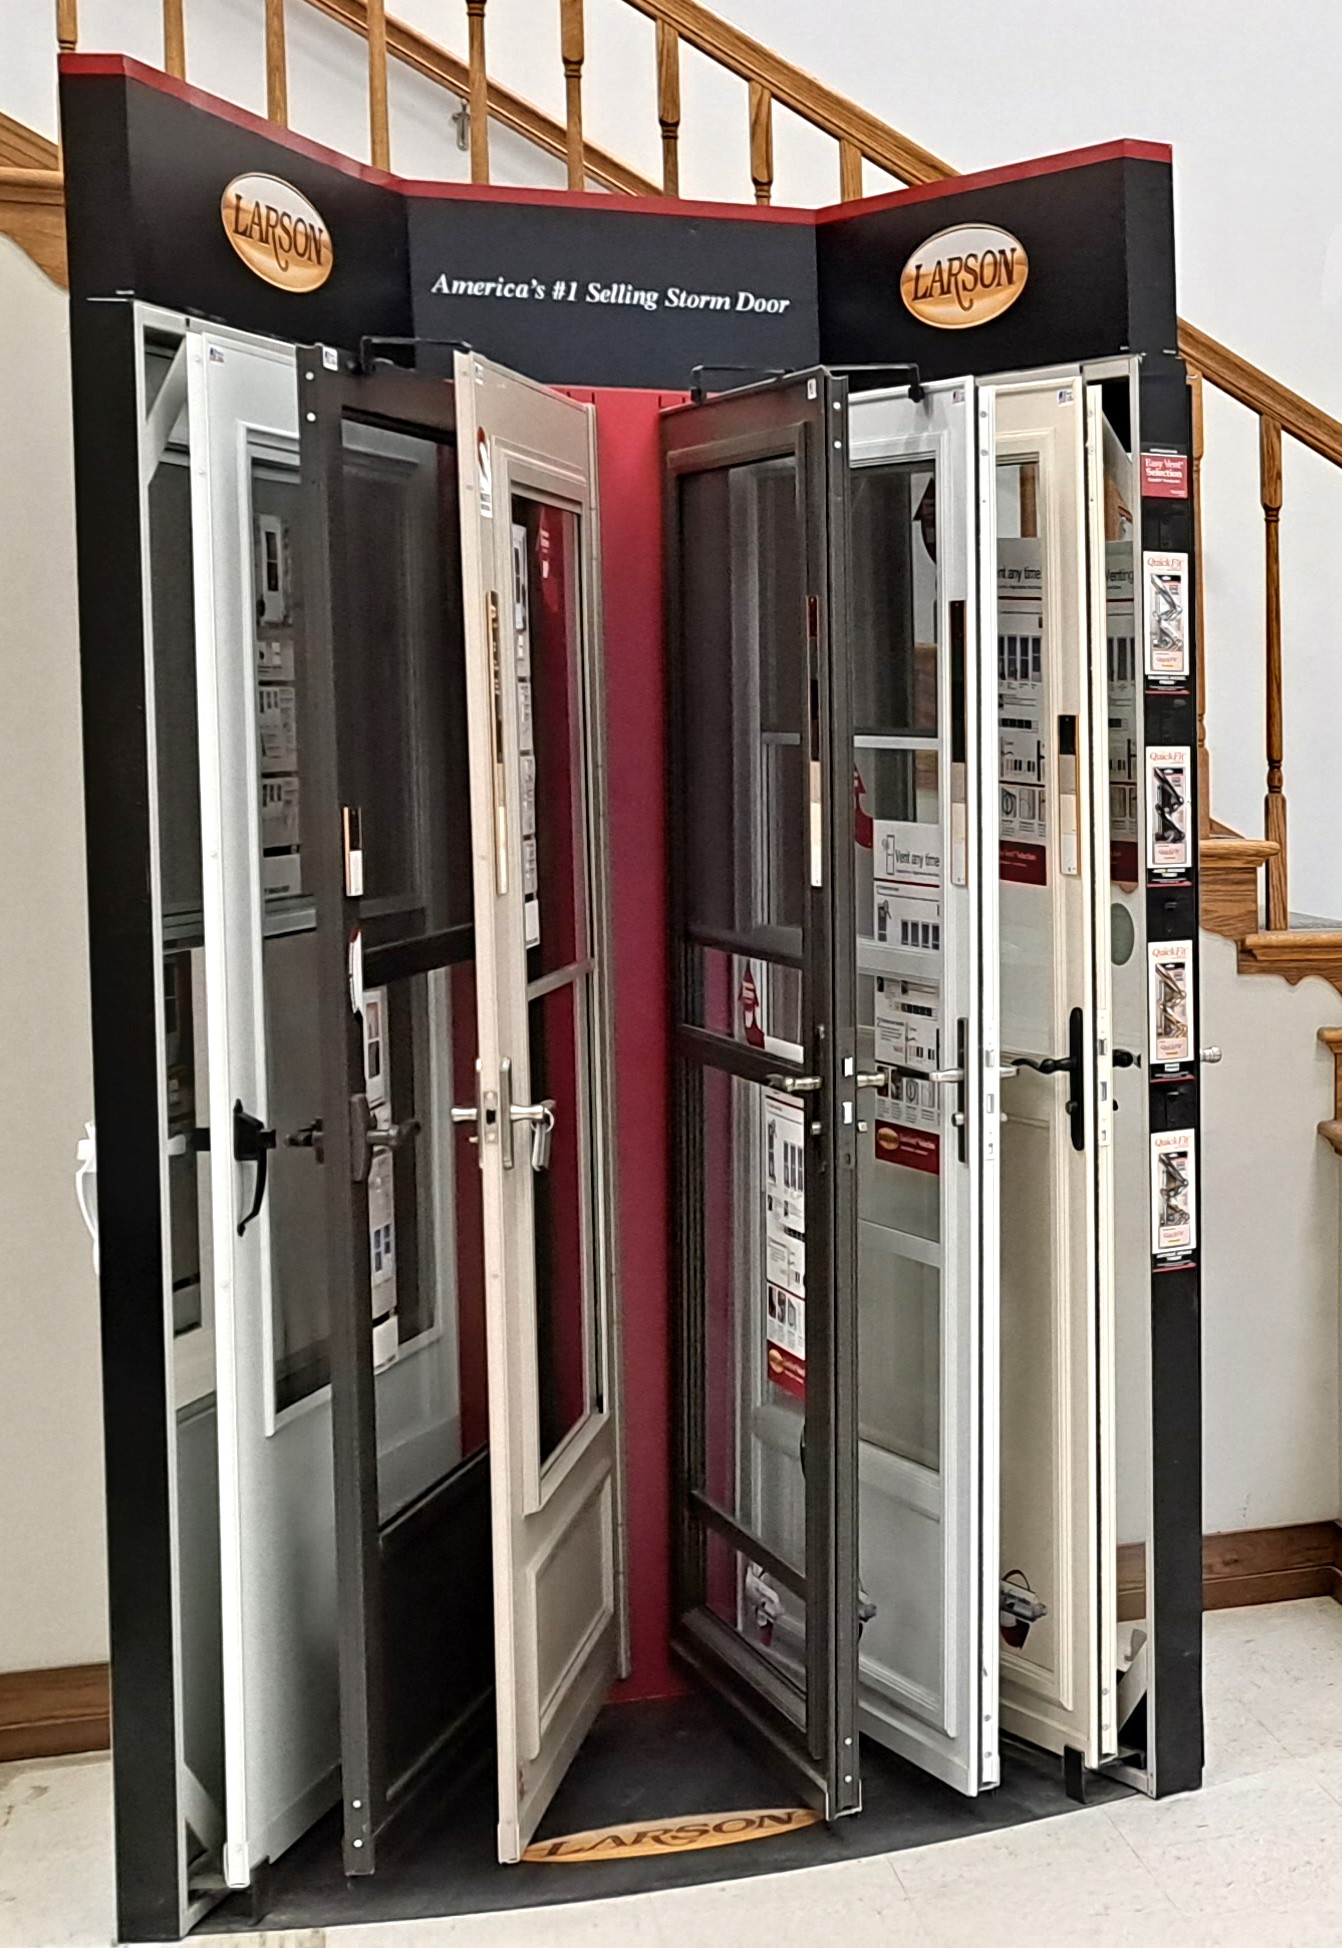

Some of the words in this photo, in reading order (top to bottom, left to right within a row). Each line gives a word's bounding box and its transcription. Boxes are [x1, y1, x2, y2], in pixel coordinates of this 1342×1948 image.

[232, 193, 323, 272] LARSON
[431, 273, 546, 300] America's
[552, 280, 578, 301] #1
[585, 282, 659, 311] Selling
[664, 287, 731, 310] Storm
[735, 291, 791, 314] Door
[911, 247, 1017, 311] LARSON
[911, 853, 924, 869] any
[925, 852, 940, 868] time
[544, 1812, 798, 1856] LARSON
